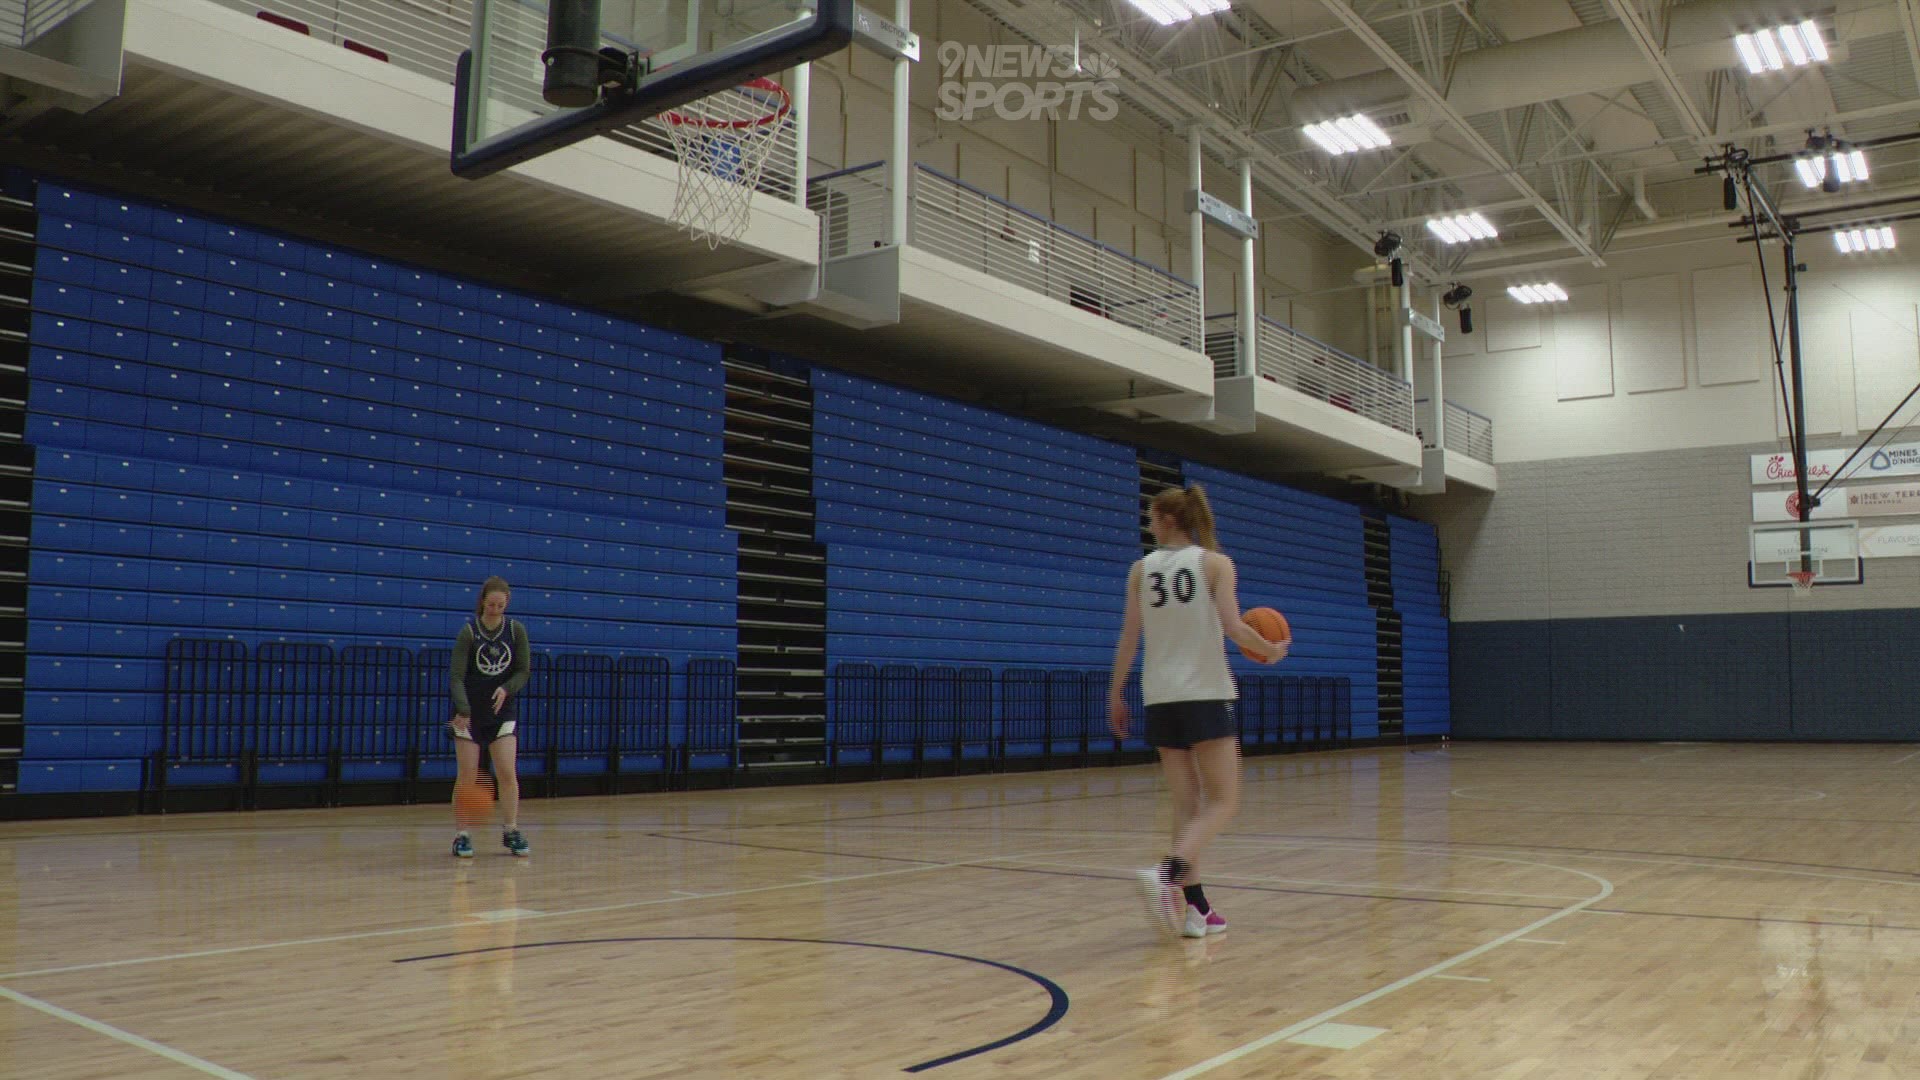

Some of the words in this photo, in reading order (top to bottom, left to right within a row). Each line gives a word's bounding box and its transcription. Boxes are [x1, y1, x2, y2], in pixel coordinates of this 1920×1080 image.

[880, 20, 907, 41] SECTION
[1888, 448, 1918, 458] MINES
[1864, 492, 1890, 500] NEW
[1148, 568, 1196, 608] 30
